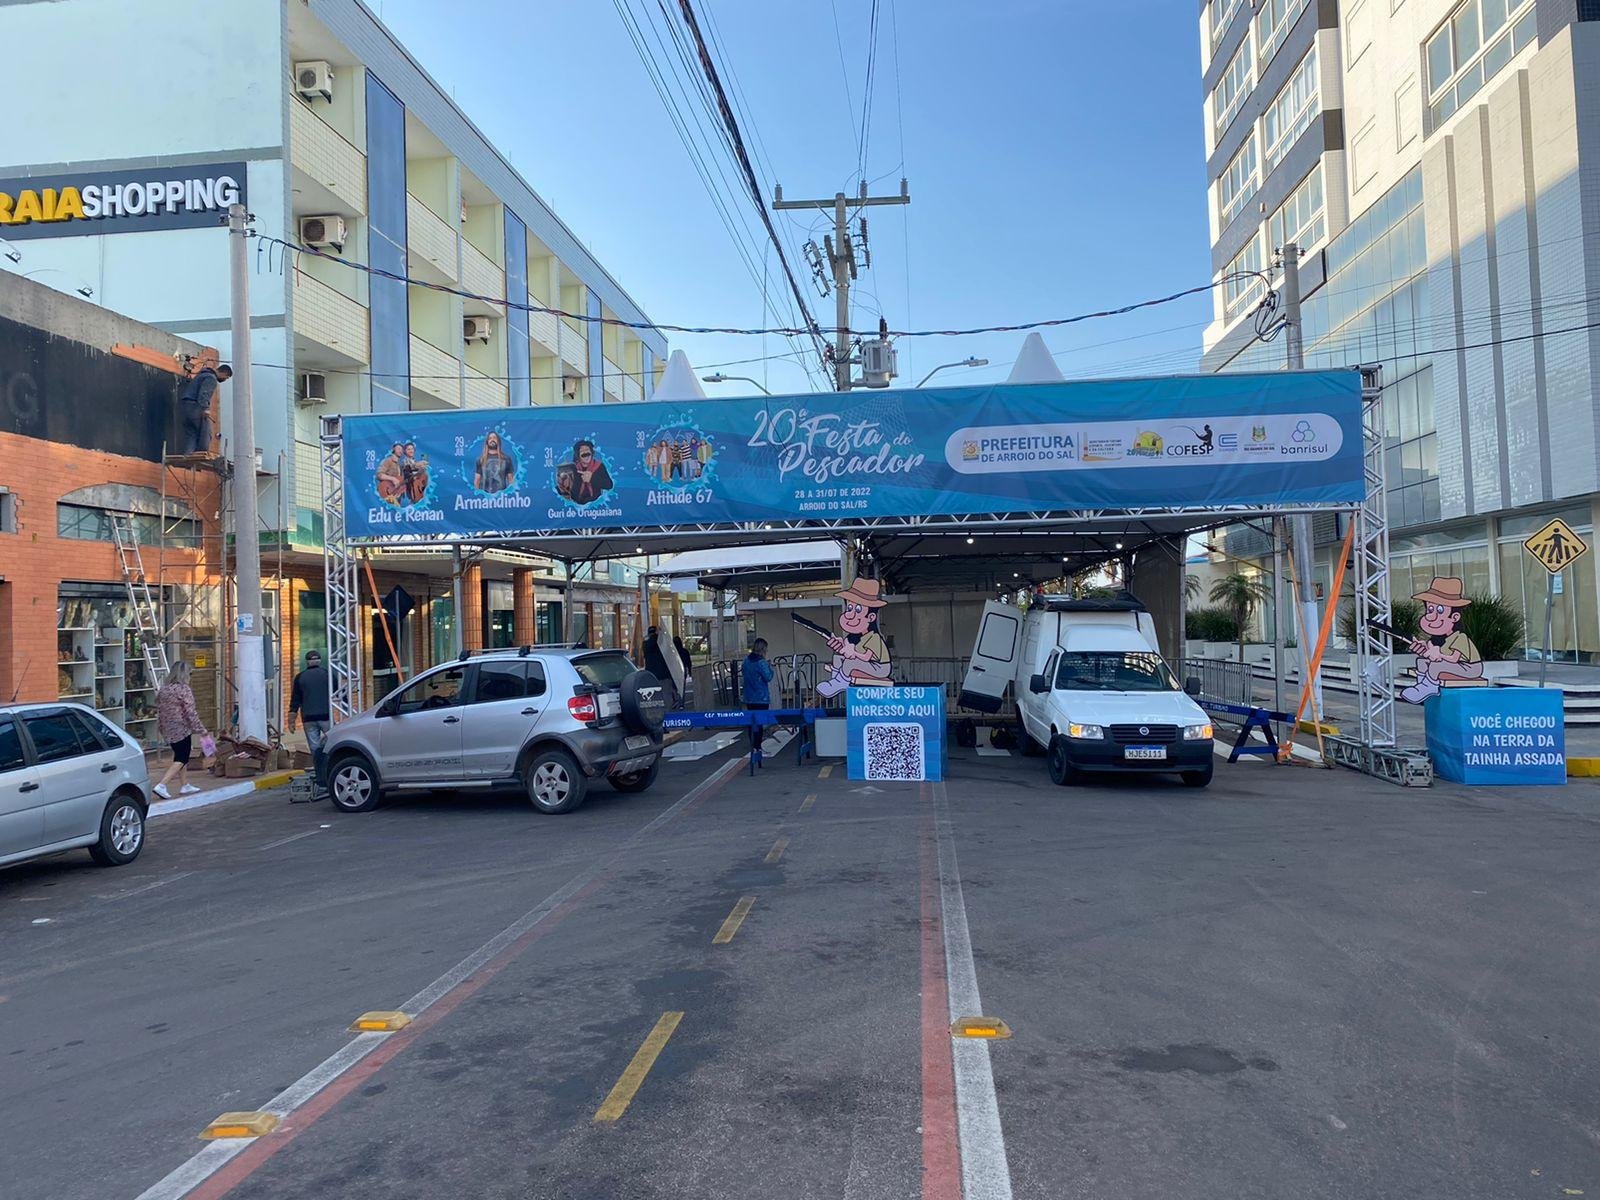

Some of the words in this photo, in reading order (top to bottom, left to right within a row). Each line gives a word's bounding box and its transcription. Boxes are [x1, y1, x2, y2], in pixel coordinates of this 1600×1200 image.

[636, 431, 645, 441] 30
[798, 413, 885, 456] Festa
[893, 431, 913, 446] do
[455, 436, 465, 448] 29
[981, 435, 1074, 452] PREFEITURA
[366, 450, 376, 462] 28
[545, 447, 553, 459] 31
[1167, 444, 1214, 456] COFESP
[1281, 443, 1328, 456] banrisul
[778, 441, 925, 484] Pescador
[981, 453, 994, 463] DE
[997, 451, 1036, 463] ARROIO
[1039, 450, 1054, 461] DO
[1056, 450, 1075, 460] SAL
[646, 488, 693, 506] Atitude
[695, 488, 713, 504] 67
[794, 489, 805, 499] 28
[807, 489, 813, 498] A
[816, 488, 837, 498] 31/07
[840, 487, 849, 497] DE
[851, 486, 872, 496] 2022
[454, 491, 531, 511] Armandinho
[799, 501, 826, 511] ARROIO
[828, 501, 839, 510] DO
[841, 500, 868, 509] SAL/RS
[368, 507, 392, 523] Edu
[395, 510, 402, 522] e
[405, 505, 444, 522] Renan
[548, 508, 565, 519] Guri
[577, 508, 622, 520] Uruguaiana
[856, 687, 901, 700] COMPRE
[904, 687, 925, 699] SEU
[851, 704, 905, 717] INGRESSO
[908, 704, 935, 717] AQUI
[1470, 713, 1501, 728] VOCÊ
[1505, 716, 1556, 729] CHEGOU
[1473, 735, 1490, 747] NA
[1493, 734, 1534, 747] TERRA
[1538, 734, 1555, 747] DA
[1465, 752, 1511, 765] TAINHA
[1514, 752, 1564, 765] ASSADA
